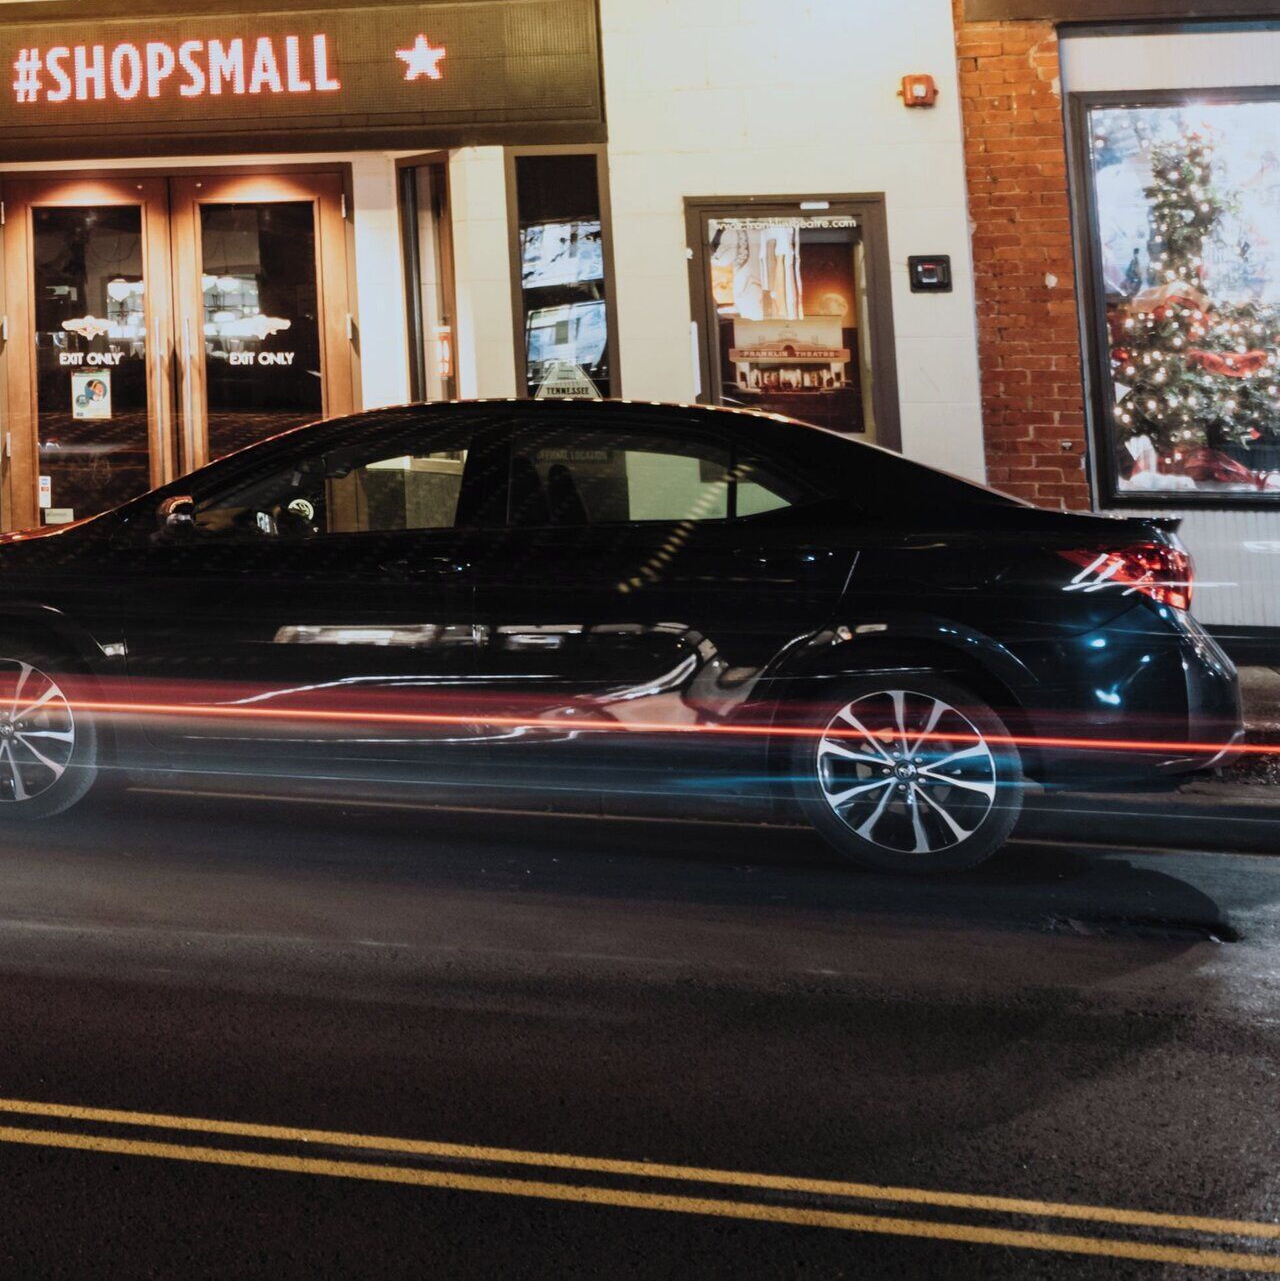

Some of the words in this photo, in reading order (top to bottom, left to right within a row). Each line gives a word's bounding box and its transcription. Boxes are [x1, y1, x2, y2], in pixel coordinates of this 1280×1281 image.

[12, 34, 341, 104] #SHOPSMALL
[59, 352, 84, 365] EXIT
[86, 352, 123, 366] ONLY
[229, 352, 255, 365] EXIT
[257, 352, 296, 366] ONLY
[546, 387, 590, 395] TENNESSEE
